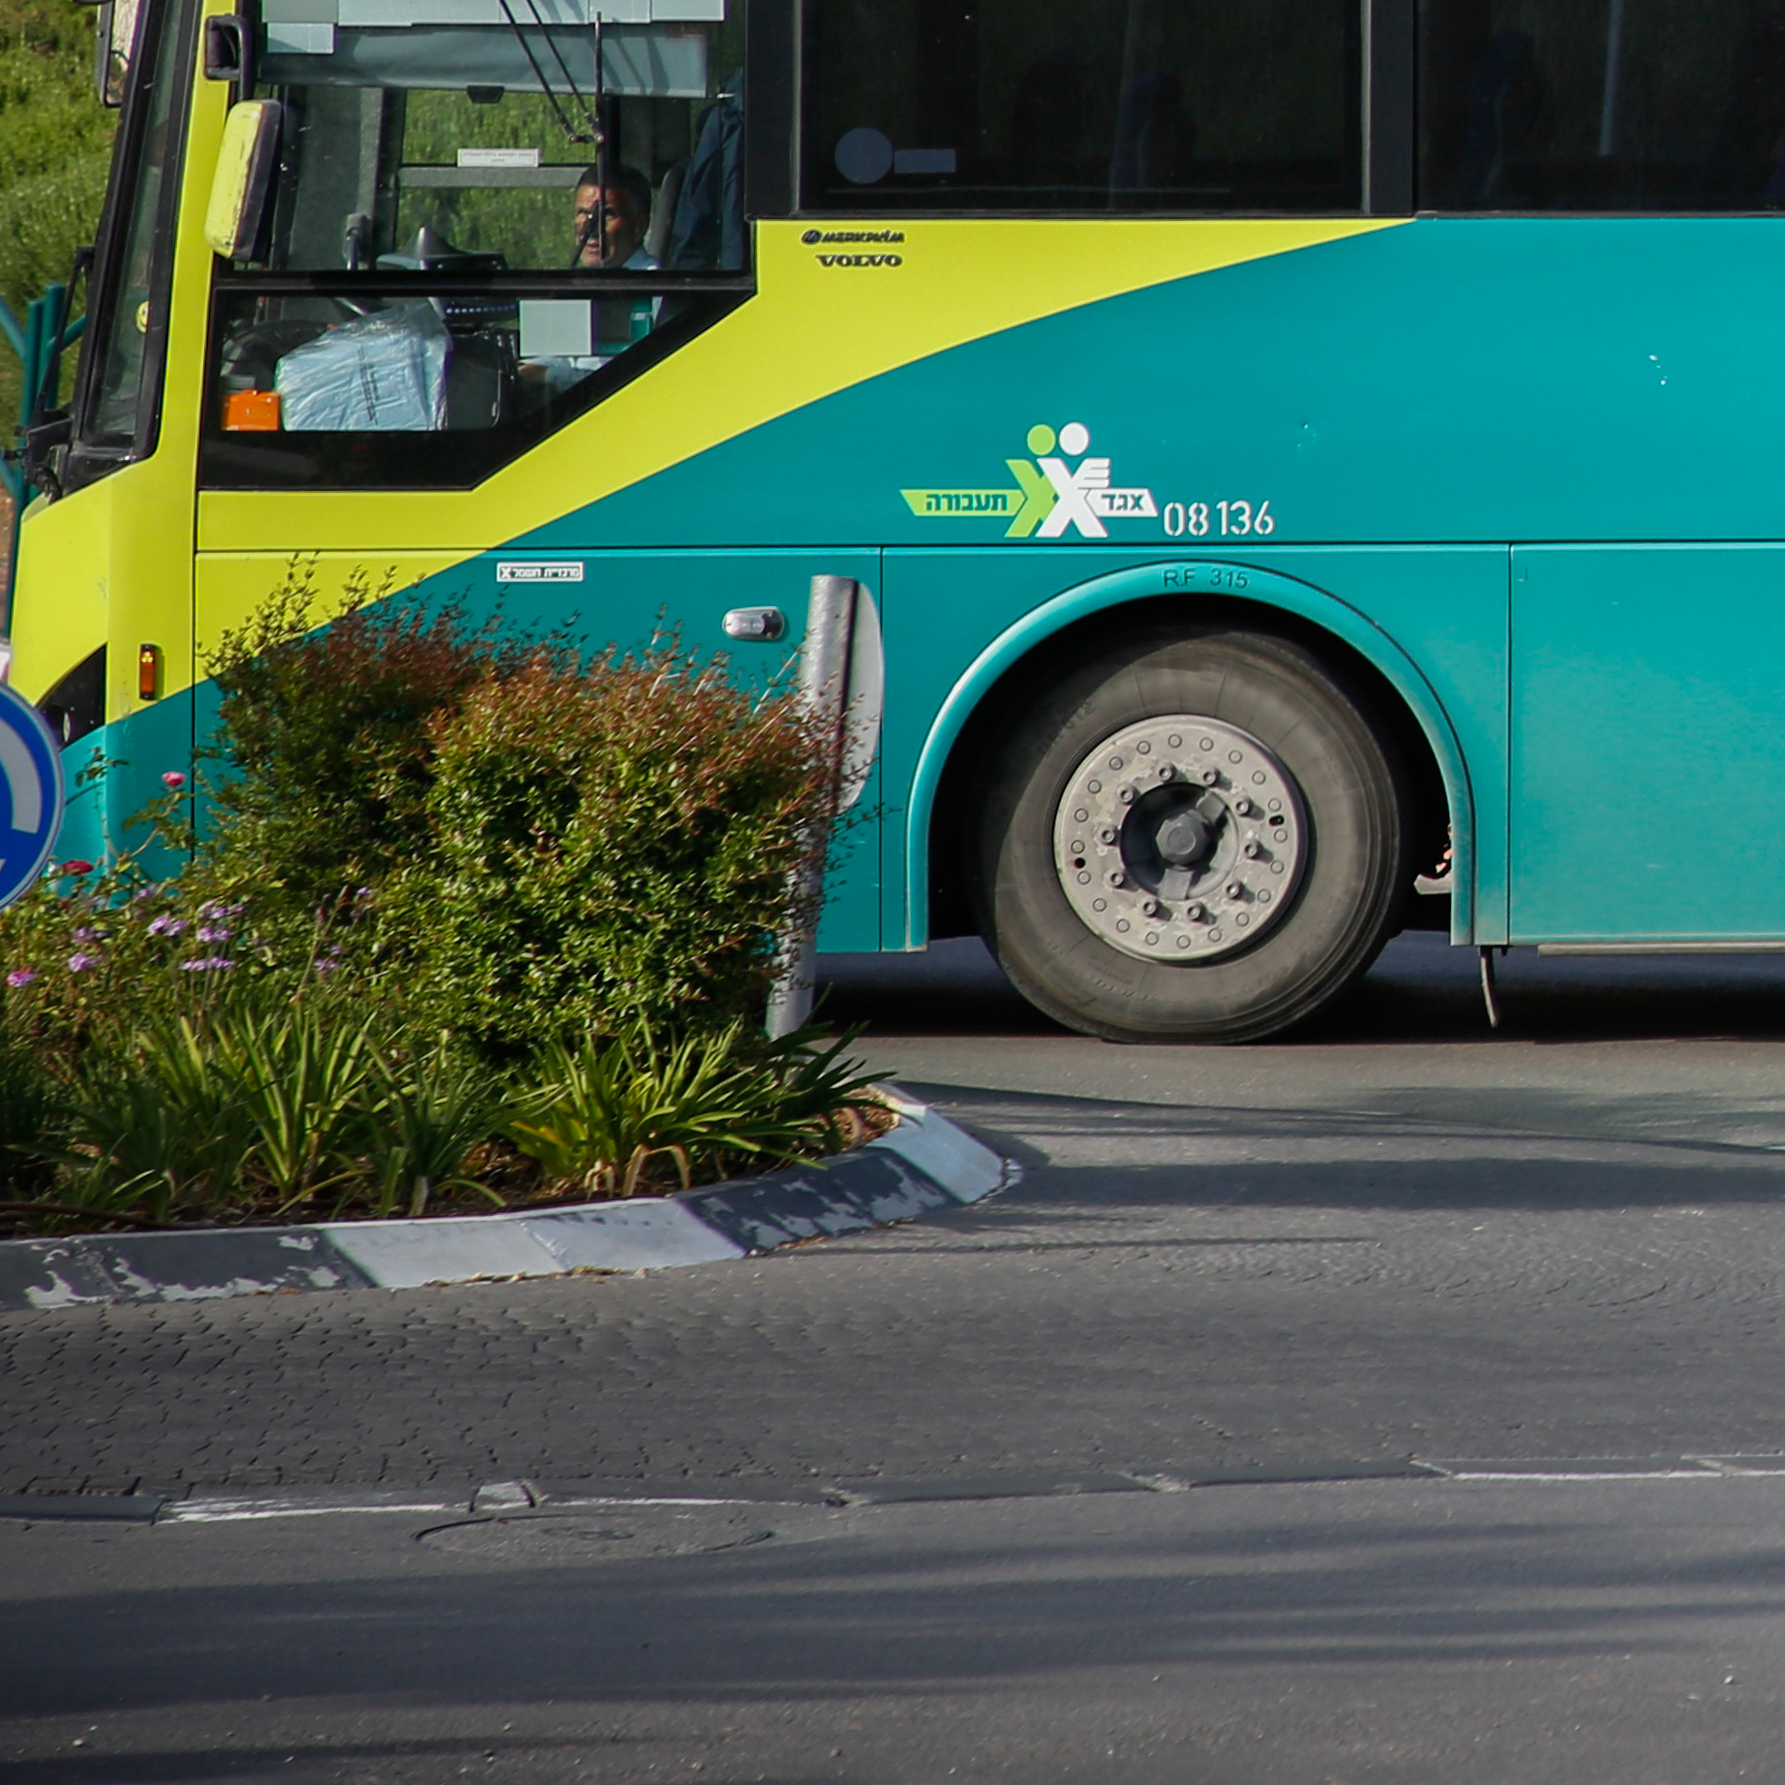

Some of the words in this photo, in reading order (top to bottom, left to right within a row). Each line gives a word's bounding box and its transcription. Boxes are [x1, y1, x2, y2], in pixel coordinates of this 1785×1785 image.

[815, 254, 903, 267] VOLVO
[925, 492, 1008, 511] תעבורה
[1209, 567, 1249, 589] 315
